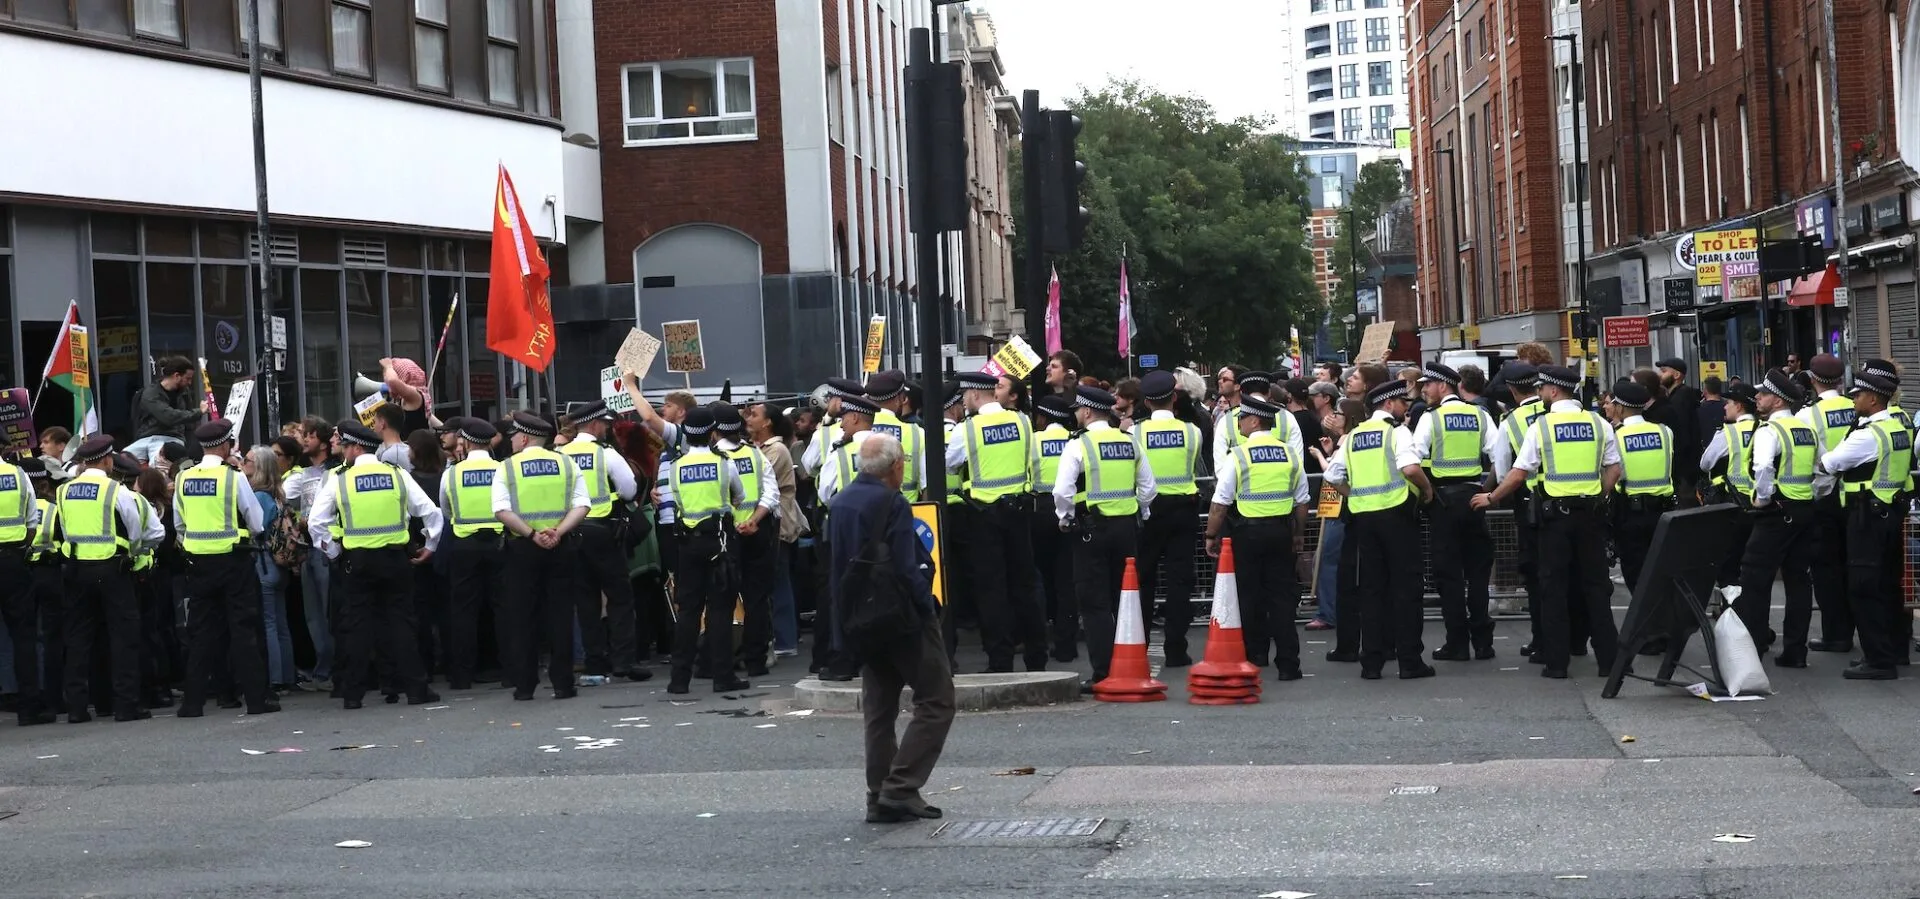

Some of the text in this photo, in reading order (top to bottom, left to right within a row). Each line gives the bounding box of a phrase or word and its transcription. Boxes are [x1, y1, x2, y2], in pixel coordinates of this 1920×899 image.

[1717, 230, 1742, 239] SHOP
[1701, 236, 1759, 252] TO LET
[1697, 253, 1724, 264] PEARL
[1725, 252, 1732, 262] &
[1699, 265, 1716, 274] 020
[1671, 280, 1685, 289] Dry
[1668, 289, 1690, 297] Clean
[1004, 344, 1031, 374] Refugees
[1446, 415, 1478, 429] POLICE
[985, 425, 1019, 442] POLICE
[1148, 432, 1183, 446] POLICE
[1556, 425, 1593, 439] POLICE
[1353, 433, 1381, 449] POLICE
[1626, 434, 1661, 449] POLICE
[1101, 444, 1134, 457] POLICE
[1251, 447, 1286, 461] POLICE
[523, 460, 558, 475] POLICE
[681, 465, 716, 481] POLICE
[0, 476, 16, 489] ICE
[184, 480, 215, 494] POLICE
[356, 475, 393, 490] POLICE
[68, 484, 97, 498] POLICE
